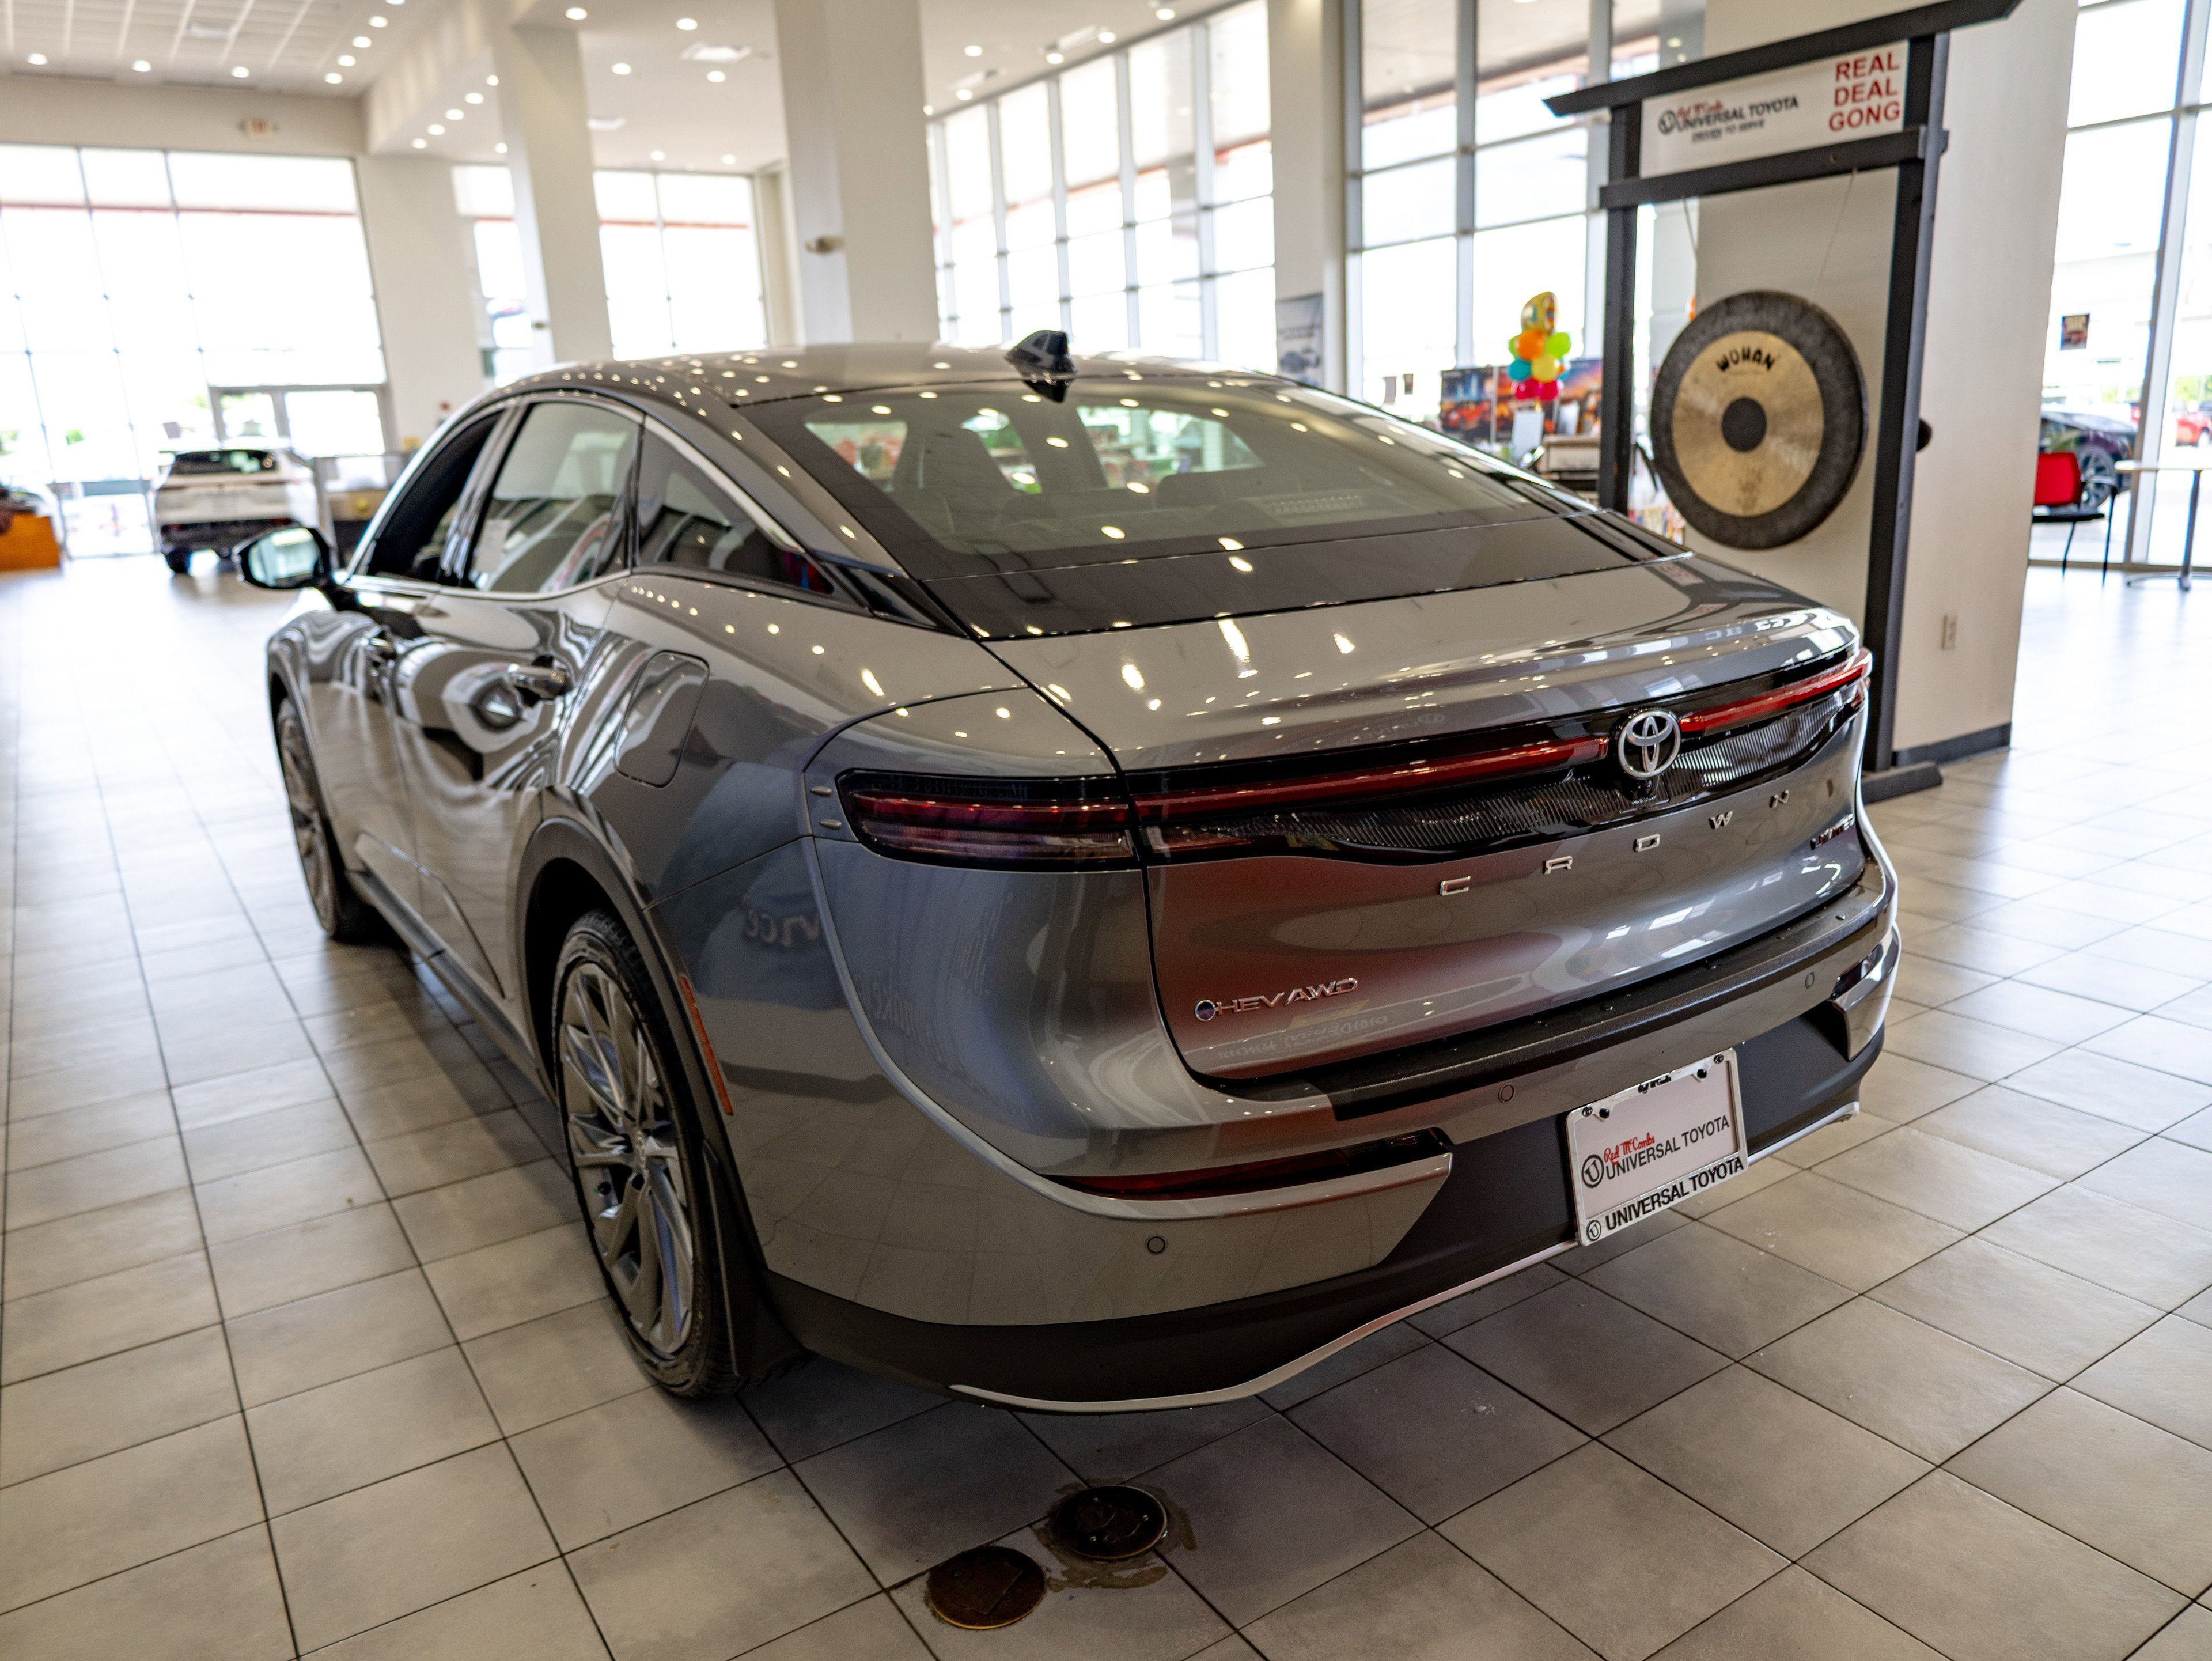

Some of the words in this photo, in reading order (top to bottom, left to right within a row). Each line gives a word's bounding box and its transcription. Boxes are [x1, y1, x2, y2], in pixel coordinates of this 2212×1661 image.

[1836, 52, 1900, 82] REAL
[1834, 77, 1898, 107] DEAL
[1677, 107, 1745, 132] UNIVERSAL
[1749, 96, 1798, 116] TOYOTA
[1828, 101, 1900, 131] GONG
[1215, 992, 1285, 1016] HEV
[1284, 977, 1358, 1005] AWD
[1604, 1146, 1619, 1166] Red
[1620, 1132, 1655, 1156] McCombs
[1606, 1137, 1681, 1180] UNIVERSAL
[1681, 1115, 1730, 1147] TOYOTA
[1605, 1181, 1690, 1231] UNIVERSAL
[1688, 1156, 1744, 1191] TOYOTA
